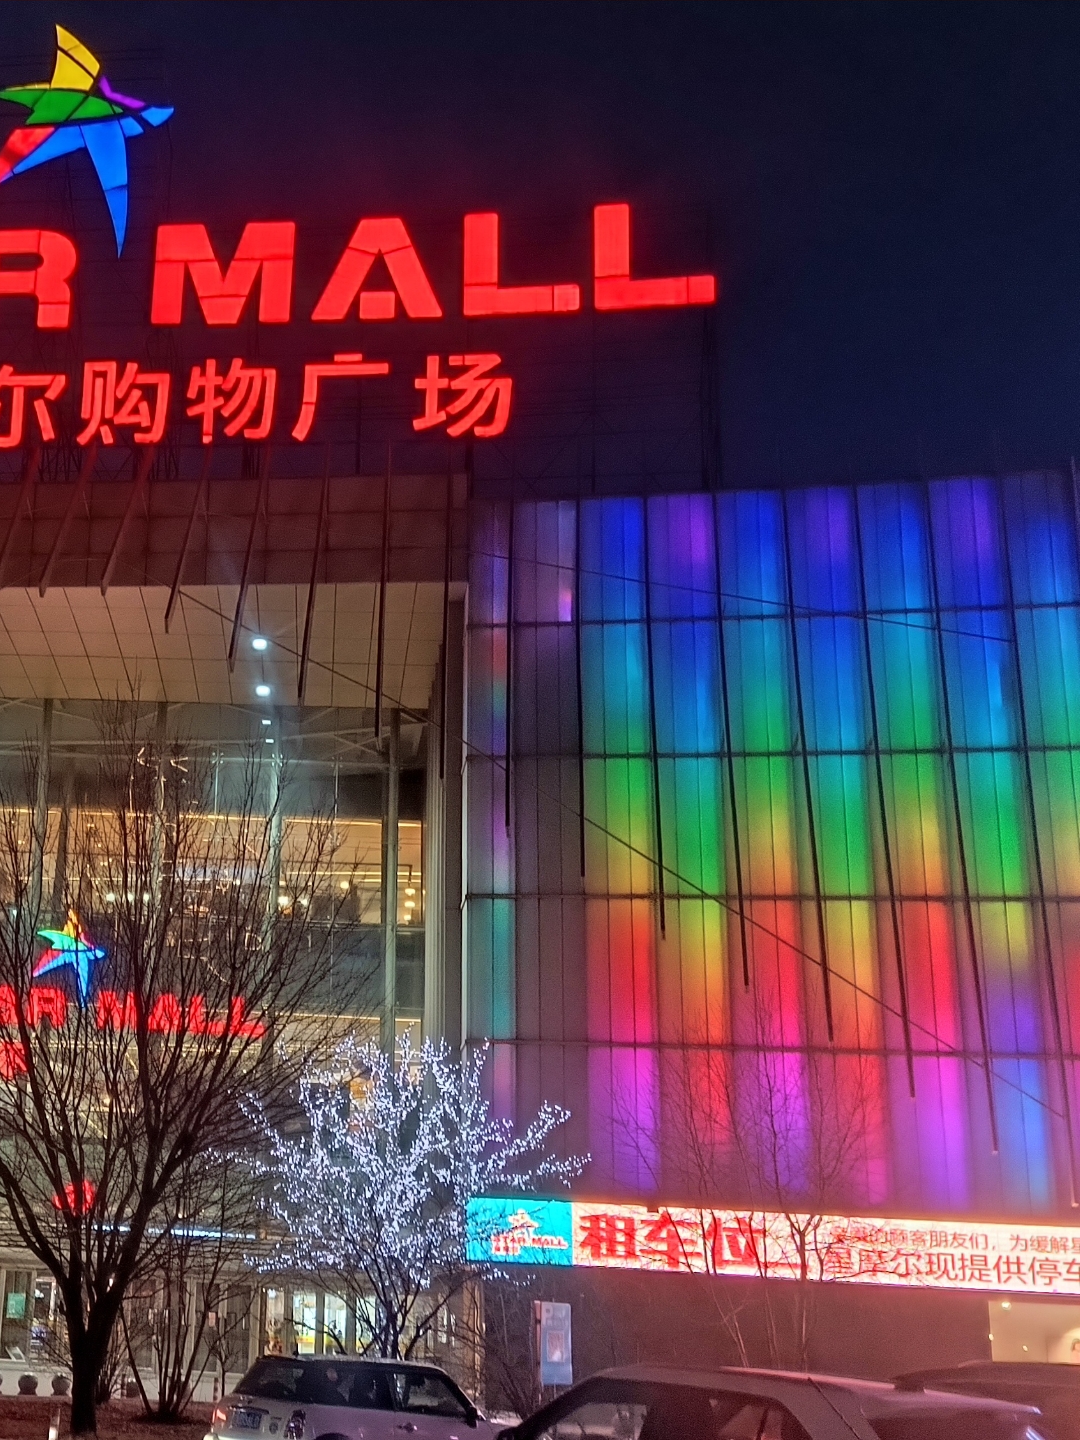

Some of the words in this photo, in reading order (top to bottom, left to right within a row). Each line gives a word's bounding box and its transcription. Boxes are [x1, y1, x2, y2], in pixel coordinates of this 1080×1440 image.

[151, 203, 716, 326] MALL
[97, 990, 266, 1038] MALL
[579, 1210, 808, 1271] 租车位
